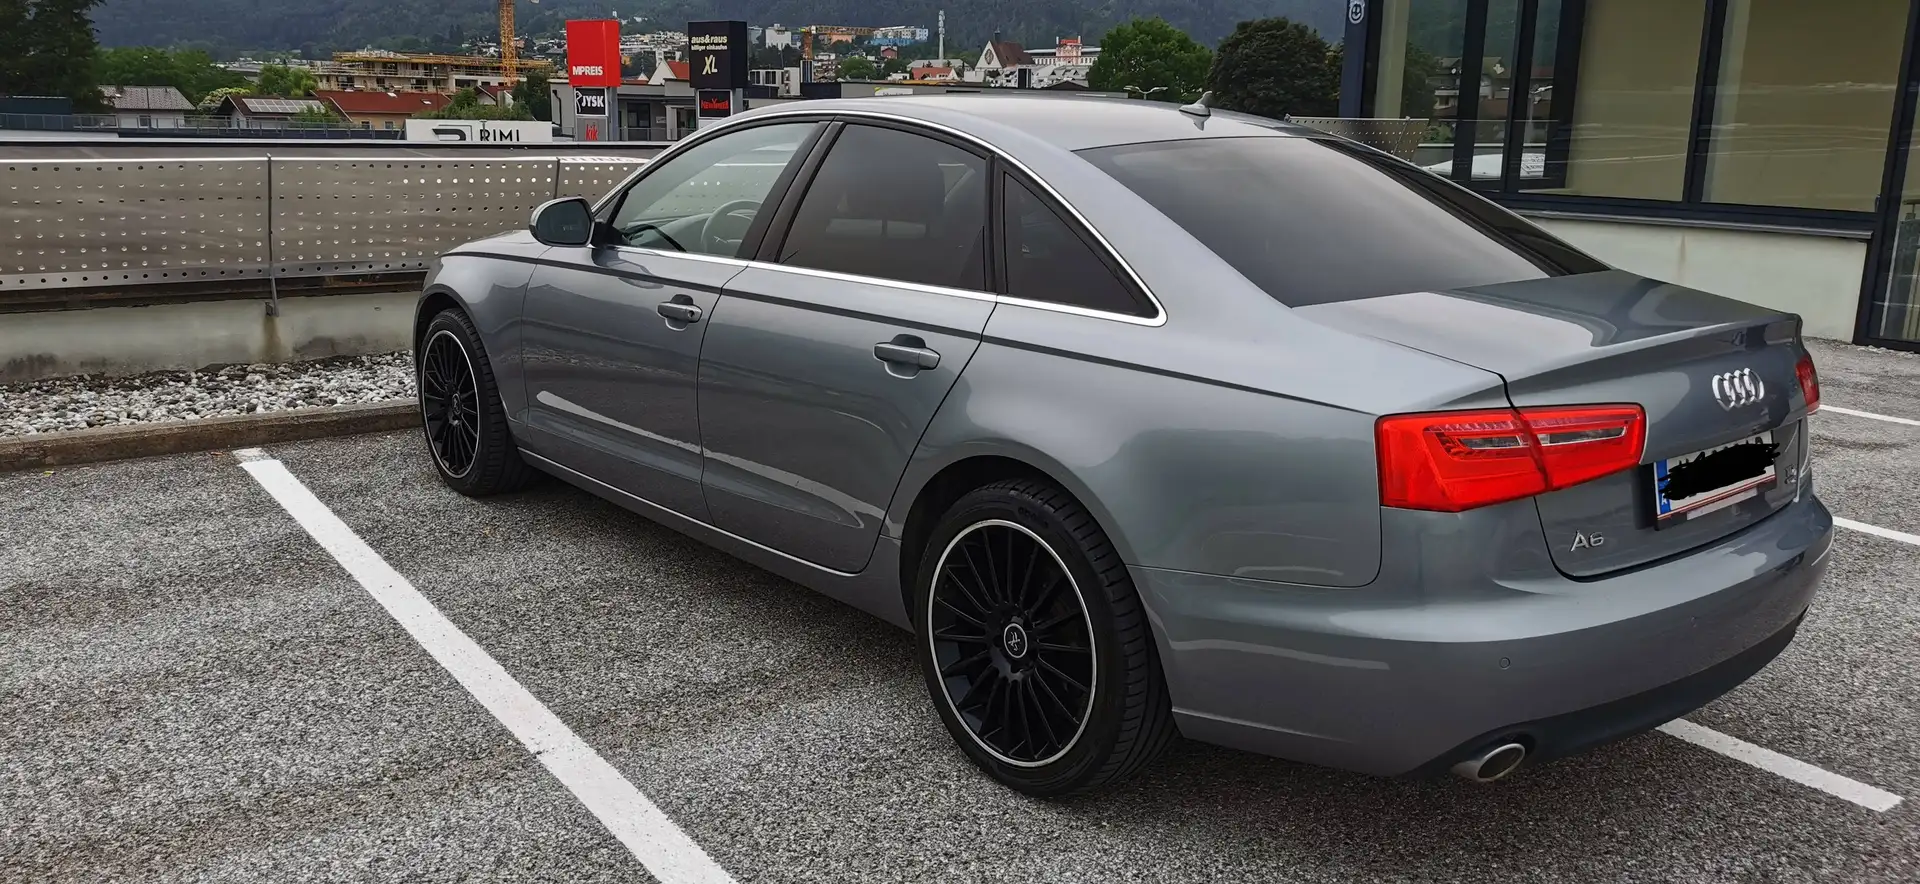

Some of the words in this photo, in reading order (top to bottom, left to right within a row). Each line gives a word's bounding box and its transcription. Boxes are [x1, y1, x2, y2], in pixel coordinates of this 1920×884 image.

[691, 34, 728, 44] aus&raus
[572, 65, 604, 76] MPREIS
[702, 54, 718, 75] XL
[581, 95, 604, 108] JYSK
[479, 128, 520, 142] RIMI
[1570, 530, 1604, 552] A6
